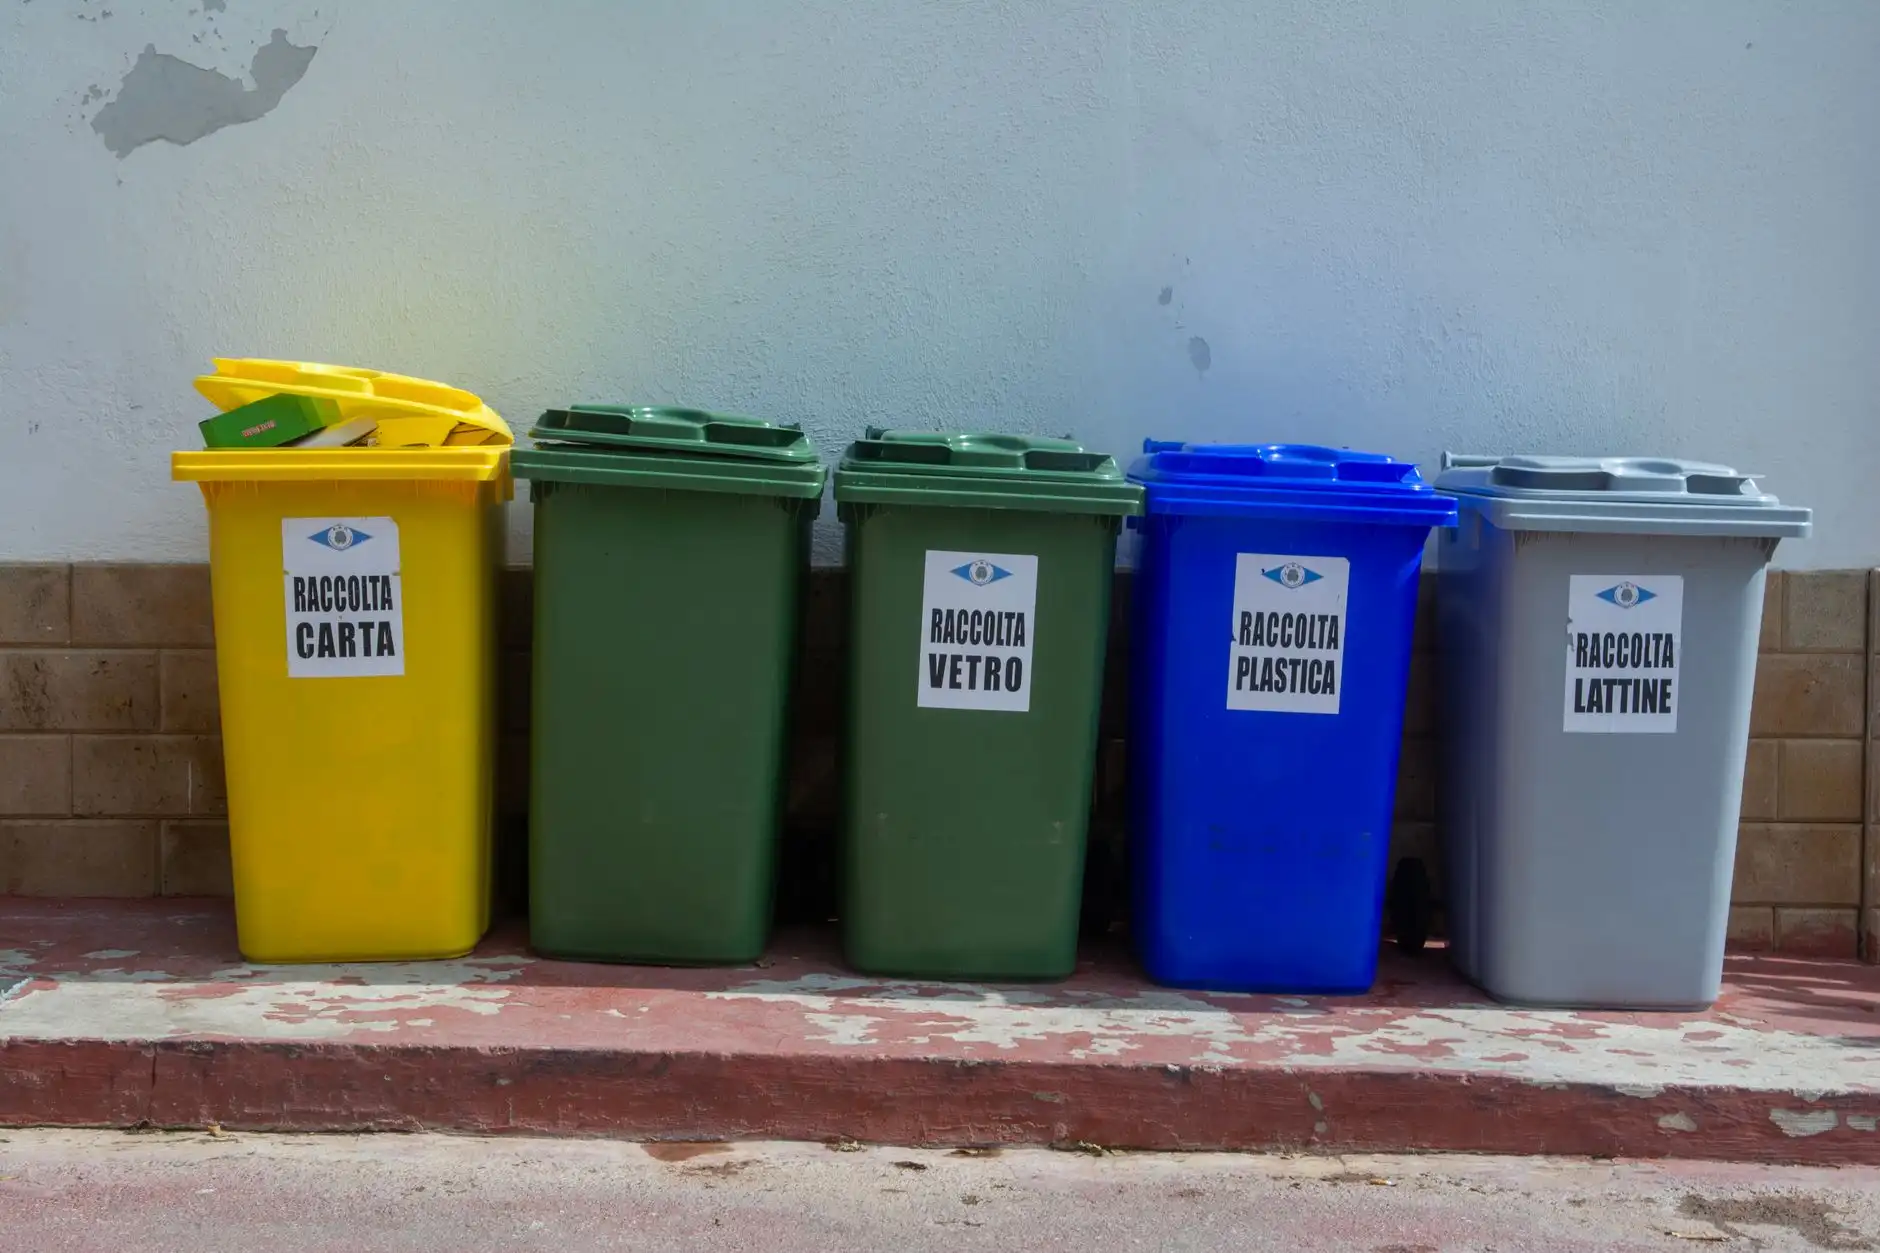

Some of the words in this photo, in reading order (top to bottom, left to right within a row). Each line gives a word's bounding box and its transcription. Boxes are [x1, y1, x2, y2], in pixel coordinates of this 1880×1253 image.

[293, 575, 393, 612] RACCOLTA
[296, 621, 395, 658] CARTA
[930, 608, 1025, 647] RACCOLTA
[1239, 611, 1339, 650] RACCOLTA
[1576, 632, 1674, 668] RACCOLTA
[928, 653, 1023, 692] VETRO
[1236, 656, 1335, 695] PLASTICA
[1574, 678, 1672, 714] LATTINE
